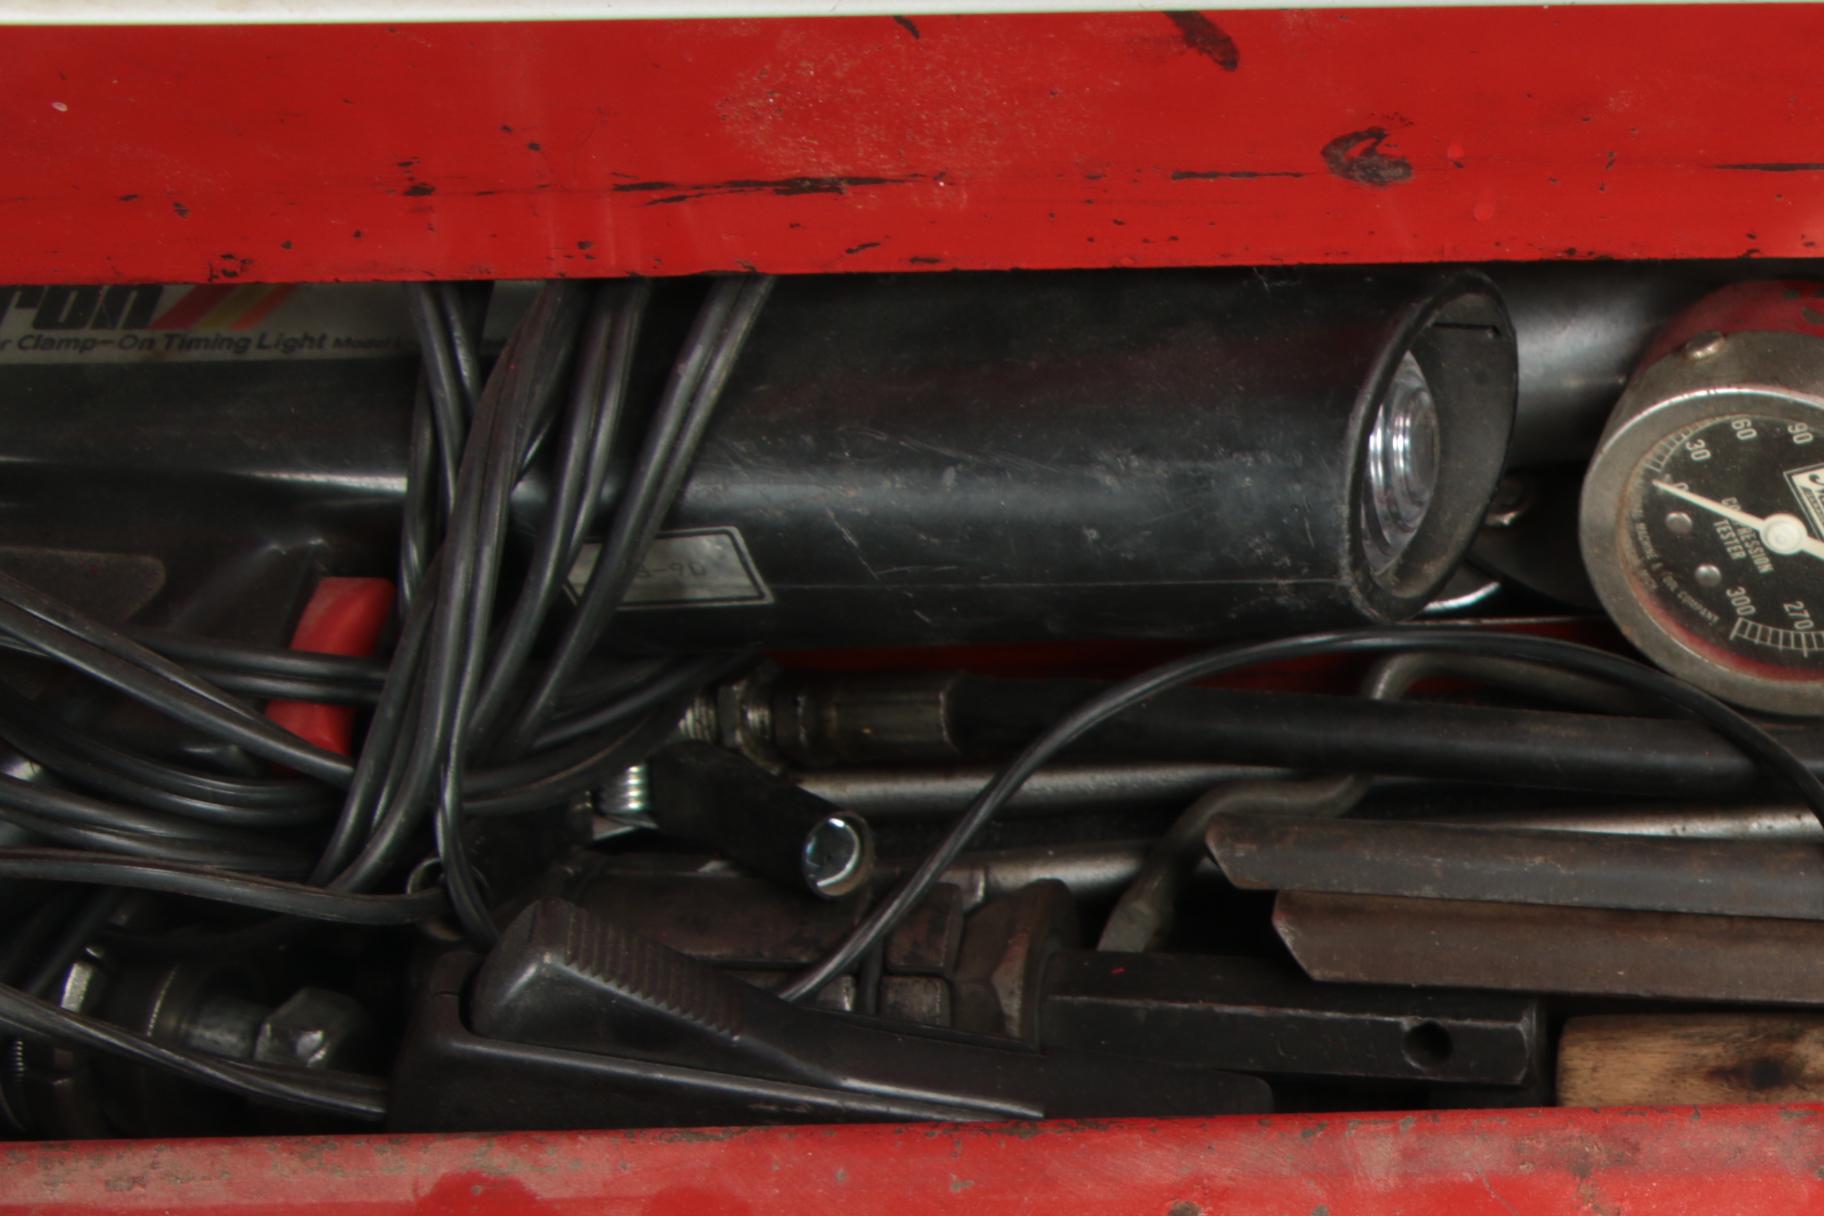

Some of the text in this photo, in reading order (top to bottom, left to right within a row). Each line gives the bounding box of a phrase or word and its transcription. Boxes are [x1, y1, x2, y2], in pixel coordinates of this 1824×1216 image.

[17, 334, 155, 354] Clamp-On
[164, 332, 251, 354] Timing
[256, 331, 328, 354] Light
[1731, 418, 1757, 440] 60
[1787, 422, 1814, 445] 90
[1685, 439, 1711, 462] 30
[1713, 519, 1747, 560] TESTER
[1726, 586, 1756, 617] 300
[1783, 601, 1814, 630] 270
